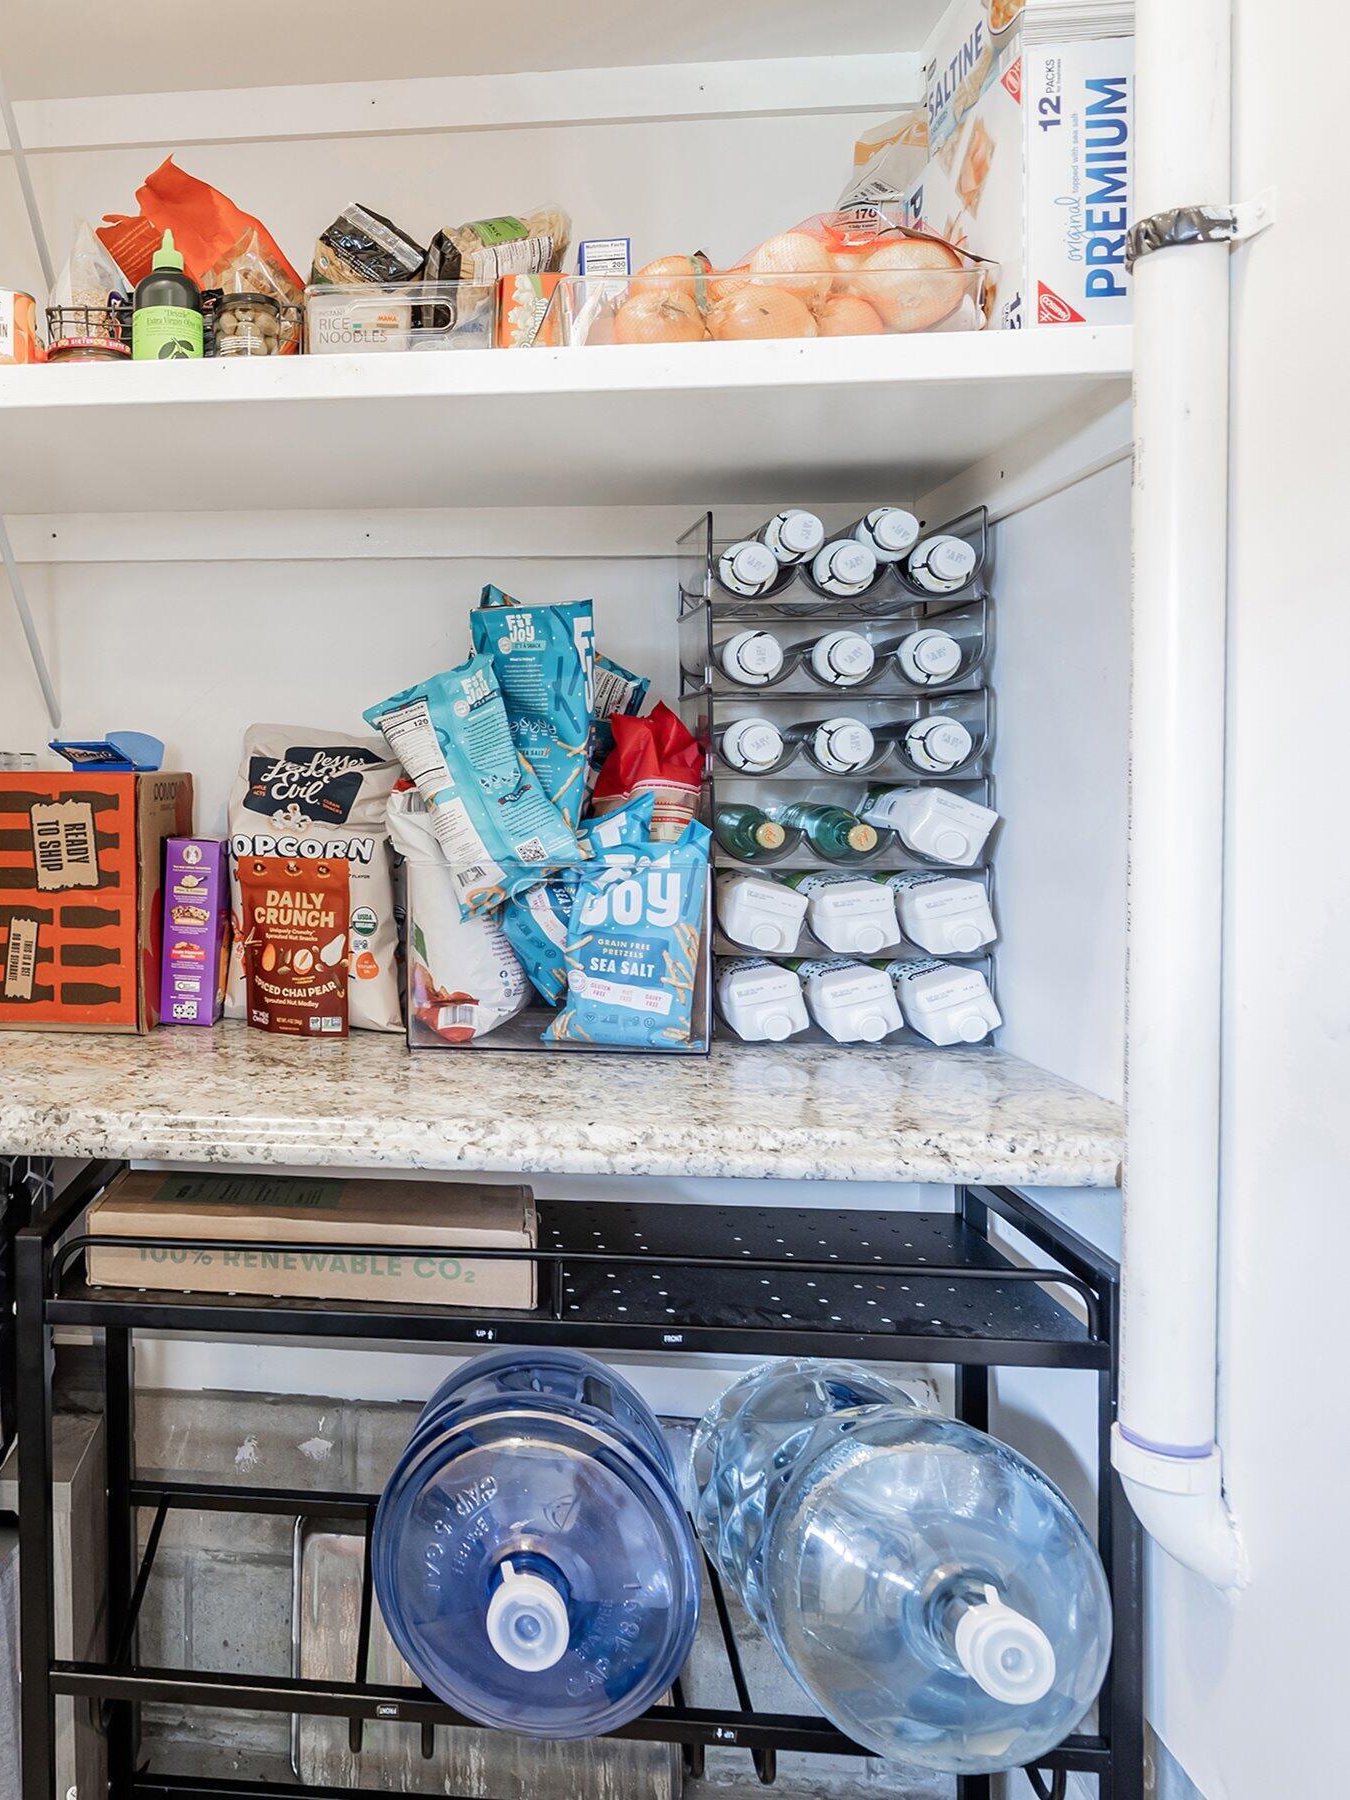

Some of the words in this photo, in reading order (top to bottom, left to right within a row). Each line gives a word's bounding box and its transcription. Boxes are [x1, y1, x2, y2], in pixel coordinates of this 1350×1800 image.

[928, 20, 983, 126] SALTINE
[1046, 59, 1055, 94] PACKS
[1038, 95, 1061, 132] 12
[1085, 77, 1128, 298] PREMIUM
[1053, 196, 1096, 262] original
[319, 317, 351, 331] RICE
[319, 329, 388, 344] NOODLES
[271, 781, 324, 805] Evil
[37, 820, 60, 836] TO
[64, 822, 90, 864] READY
[38, 839, 64, 872] SHIP
[266, 890, 325, 909] DAILY
[254, 907, 335, 928] CRUNCH
[598, 938, 628, 948] GRAIN
[630, 941, 651, 951] FREE
[602, 948, 644, 959] PRETZELS
[590, 957, 616, 973] SEA
[620, 961, 655, 978] SALT
[282, 987, 307, 998] CHAI
[308, 981, 337, 997] PEAR
[138, 1246, 214, 1267] 100%
[222, 1249, 403, 1278] RENEWABLE
[475, 1329, 486, 1337] UP
[663, 1334, 683, 1343] FRONT
